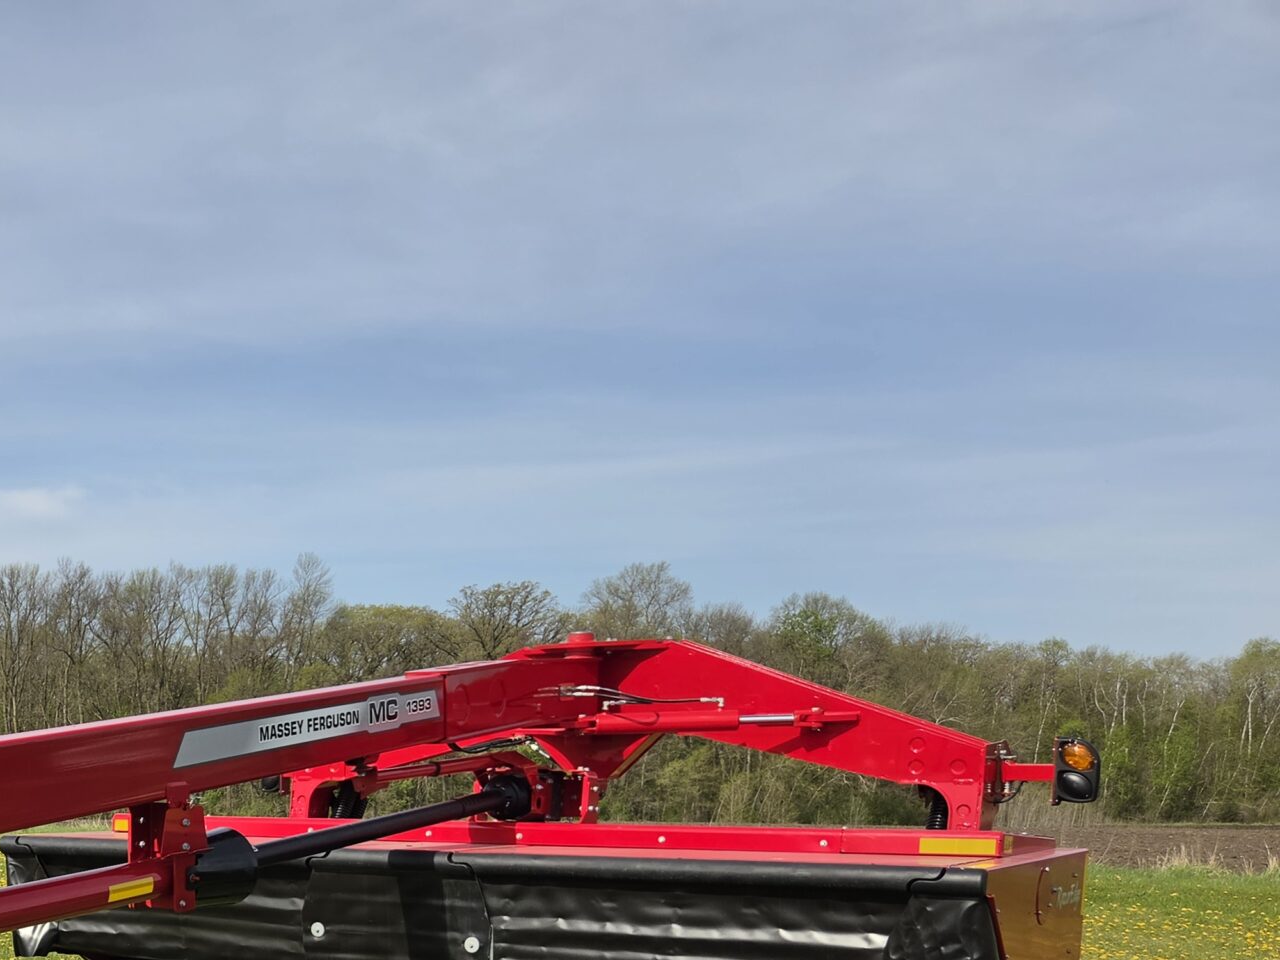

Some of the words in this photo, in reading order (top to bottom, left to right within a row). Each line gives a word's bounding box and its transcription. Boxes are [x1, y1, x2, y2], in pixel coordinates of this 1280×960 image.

[259, 720, 304, 742] MASSEY
[307, 710, 360, 732] FERGUSON
[369, 699, 399, 724] MC
[406, 698, 432, 715] 1393
